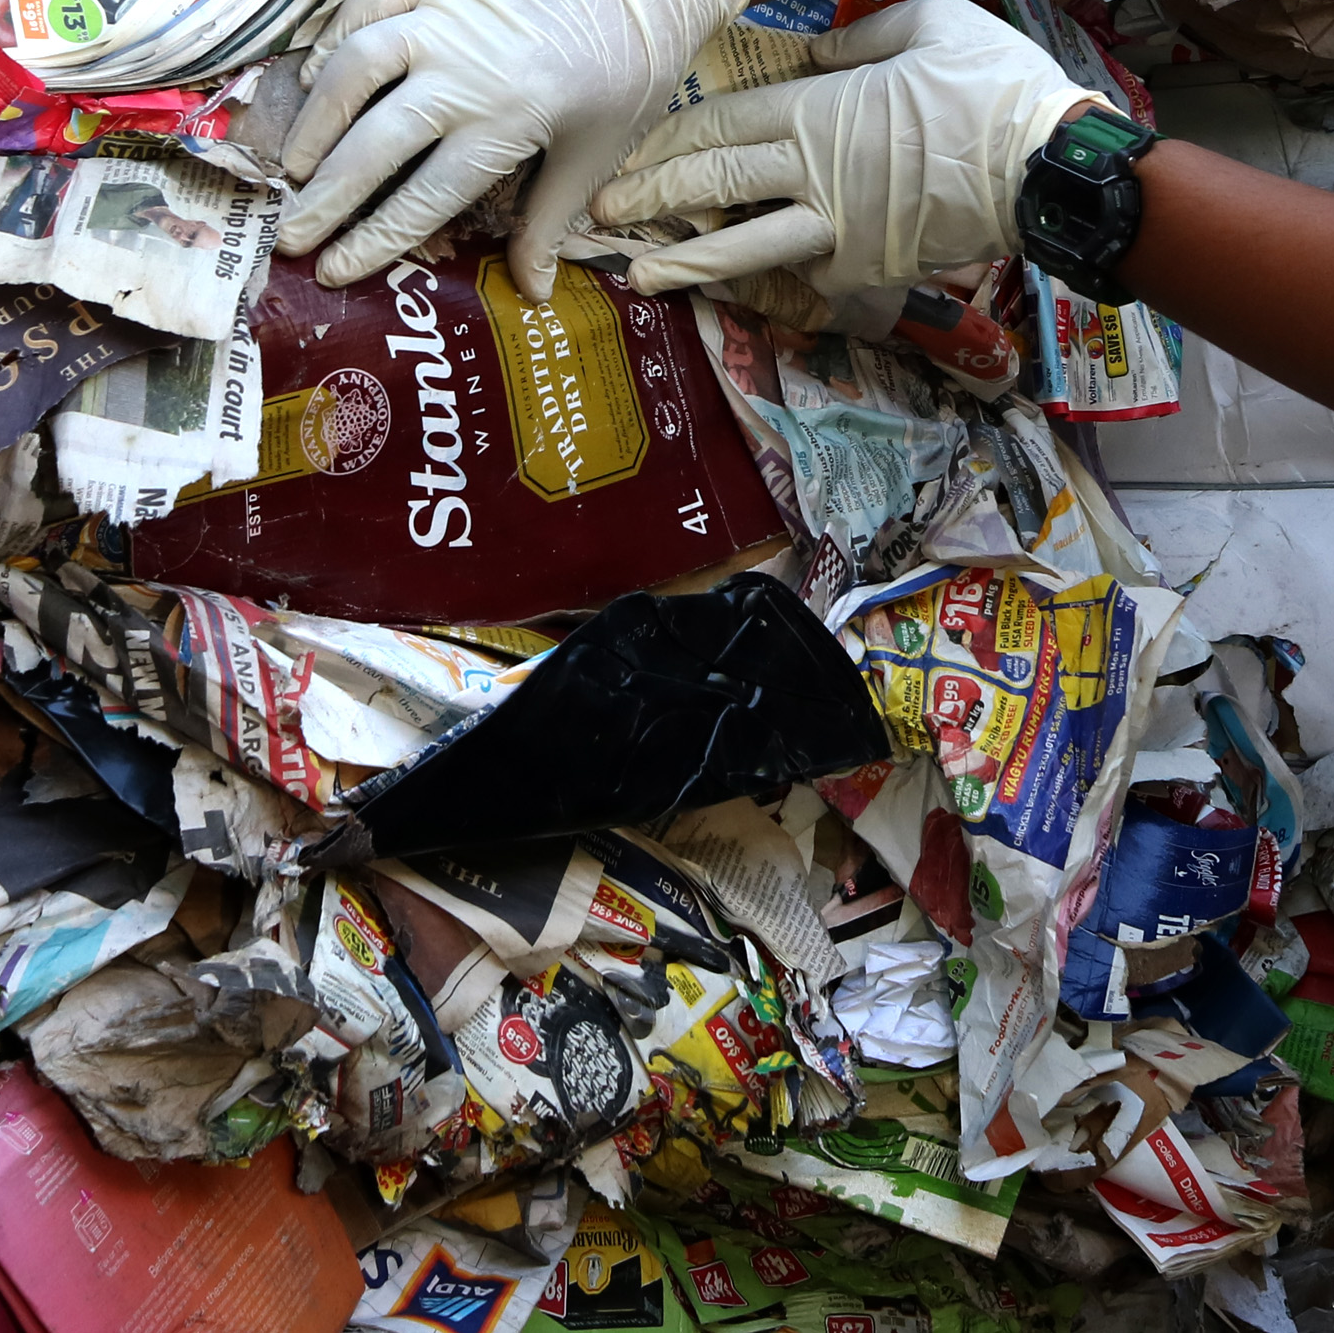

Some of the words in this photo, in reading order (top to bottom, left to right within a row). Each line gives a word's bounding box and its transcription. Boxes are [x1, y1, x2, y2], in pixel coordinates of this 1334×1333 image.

[233, 195, 255, 229] trip
[223, 231, 247, 249] to
[215, 249, 244, 281] Bris
[536, 301, 572, 361] RED
[1103, 313, 1118, 332] $6
[59, 343, 115, 382] THE
[232, 349, 255, 371] in
[1108, 333, 1123, 365] SAVE
[453, 322, 491, 456] WINES
[510, 332, 535, 421] AUSTRALIAN
[1088, 363, 1097, 406] Voltaren
[219, 376, 246, 443] court
[337, 372, 389, 430] COMPANY
[385, 257, 474, 548] Stanley
[558, 372, 589, 435] DRY
[303, 390, 332, 467] STANLEY
[342, 432, 384, 472] WINE
[677, 488, 709, 536] 4L
[983, 599, 994, 617] per
[1007, 576, 1018, 604] Angus
[1004, 603, 1014, 628] Black
[1014, 599, 1026, 627] Rumps
[1023, 615, 1034, 648] SLICED
[1000, 627, 1010, 649] Full
[1012, 627, 1021, 649] MSA
[230, 642, 256, 701] AND
[1109, 650, 1119, 675] Mon
[1106, 676, 1116, 697] Open
[1003, 751, 1028, 799] WAGYU
[1024, 698, 1048, 750] RUMPS
[1040, 670, 1051, 695] ON
[1013, 802, 1033, 848] CHICKEN
[988, 980, 1025, 1058] FoodWorks
[1155, 1138, 1177, 1169] coles
[1178, 1177, 1207, 1213] Drinks
[426, 1272, 496, 1296] ALDI
